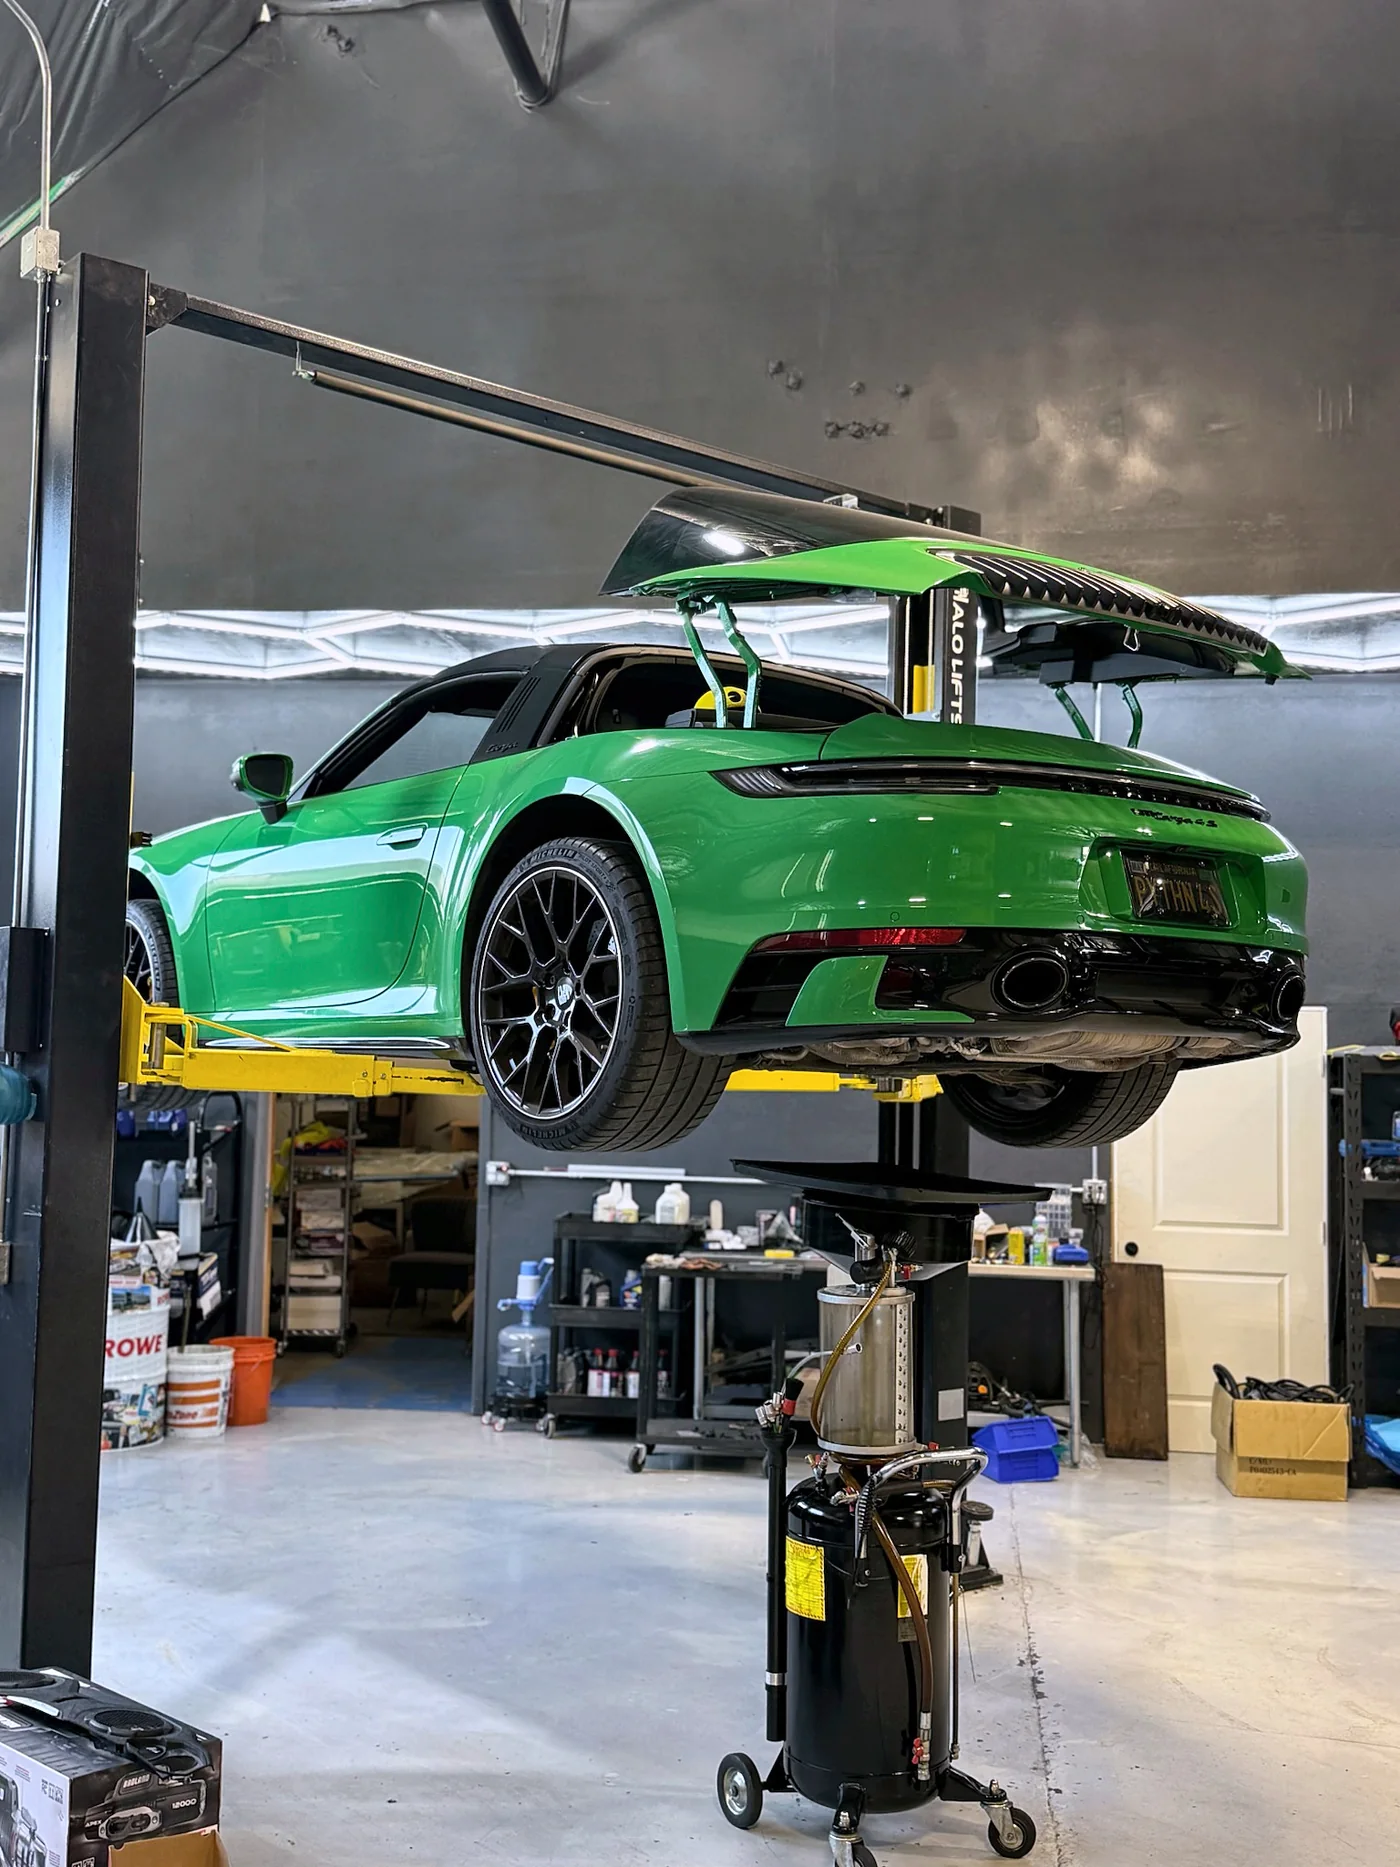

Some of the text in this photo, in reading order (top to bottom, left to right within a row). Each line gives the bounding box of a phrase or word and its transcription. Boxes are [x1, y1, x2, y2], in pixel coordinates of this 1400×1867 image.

[530, 848, 576, 861] MICHELIN
[105, 1335, 162, 1358] ROWE
[172, 1798, 197, 1809] 12000
